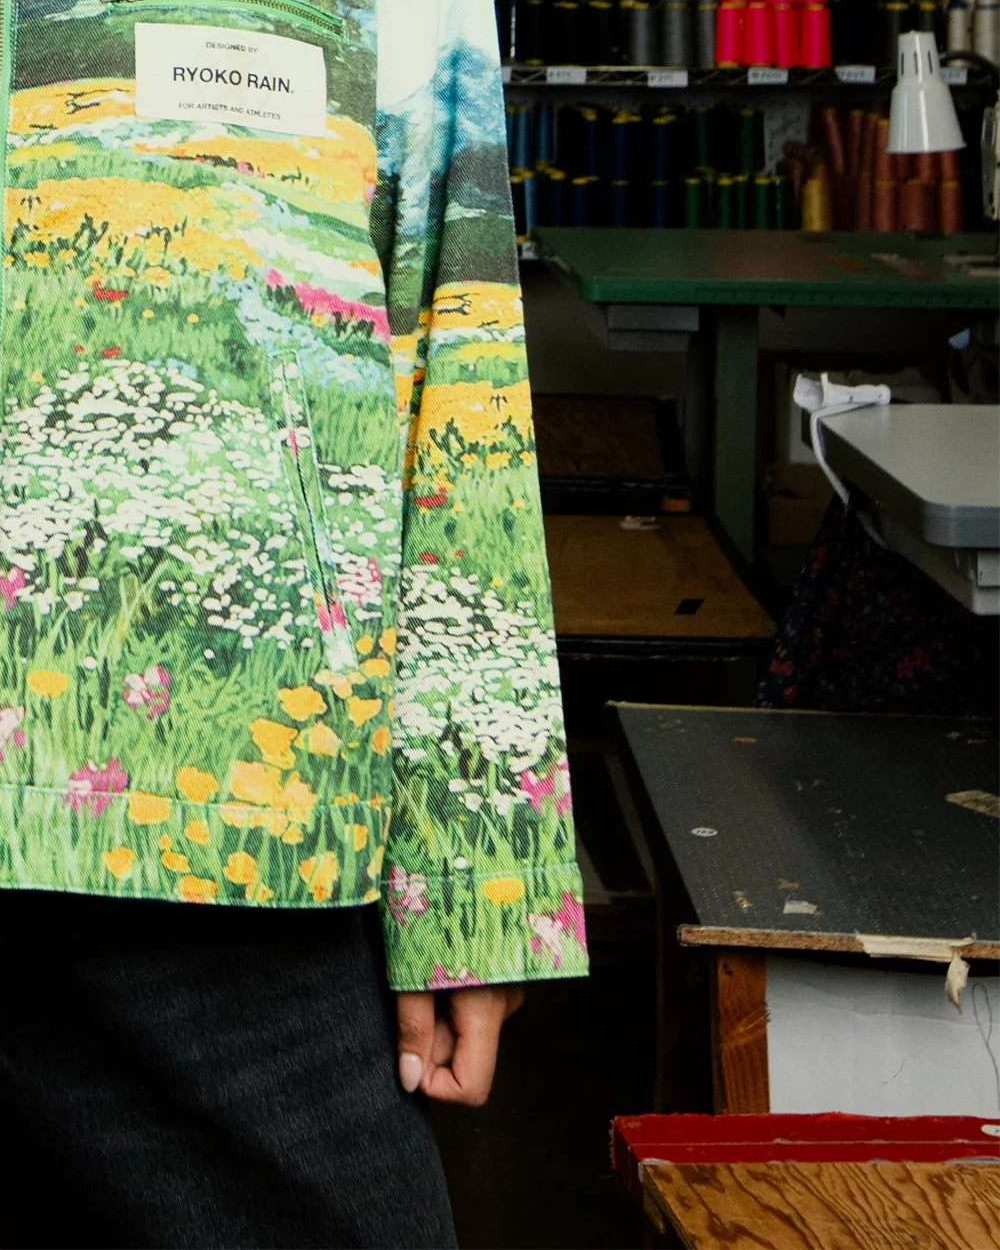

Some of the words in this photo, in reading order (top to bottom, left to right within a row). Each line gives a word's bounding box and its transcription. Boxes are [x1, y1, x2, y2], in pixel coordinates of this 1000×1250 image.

[205, 41, 247, 52] DESIGNED
[172, 66, 242, 86] RYOKO
[196, 103, 228, 111] ARTISTS
[230, 106, 244, 114] AND
[246, 109, 281, 120] ATHLETES
